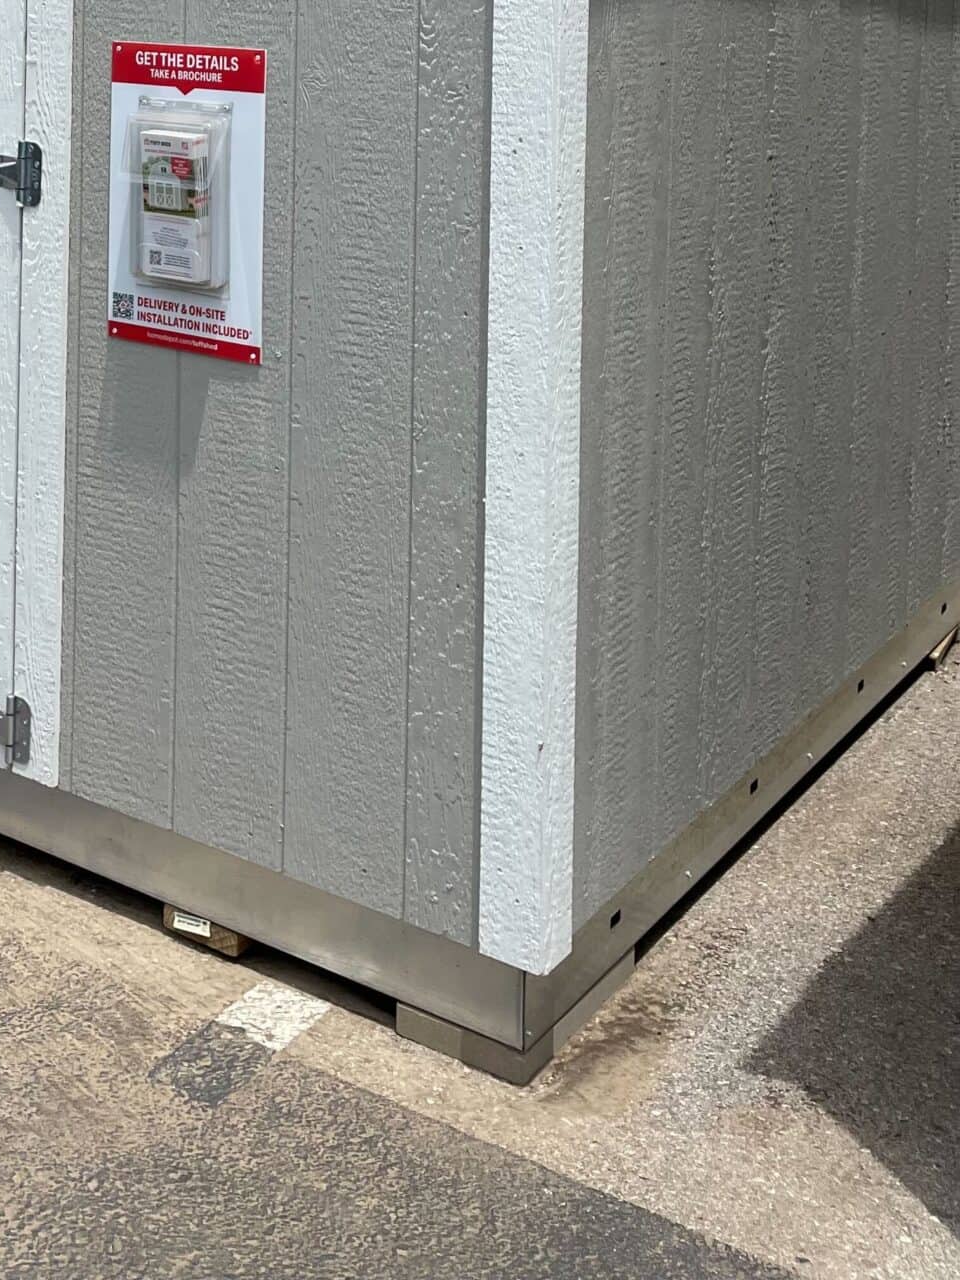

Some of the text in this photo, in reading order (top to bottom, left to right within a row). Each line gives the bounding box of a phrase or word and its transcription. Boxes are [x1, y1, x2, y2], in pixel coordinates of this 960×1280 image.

[136, 51, 239, 71] GET THE DETAILS
[150, 69, 222, 82] TAKE A BROCHURE
[137, 296, 226, 321] DELIVERY & ON-SITE
[137, 311, 200, 332] INSTALLATION
